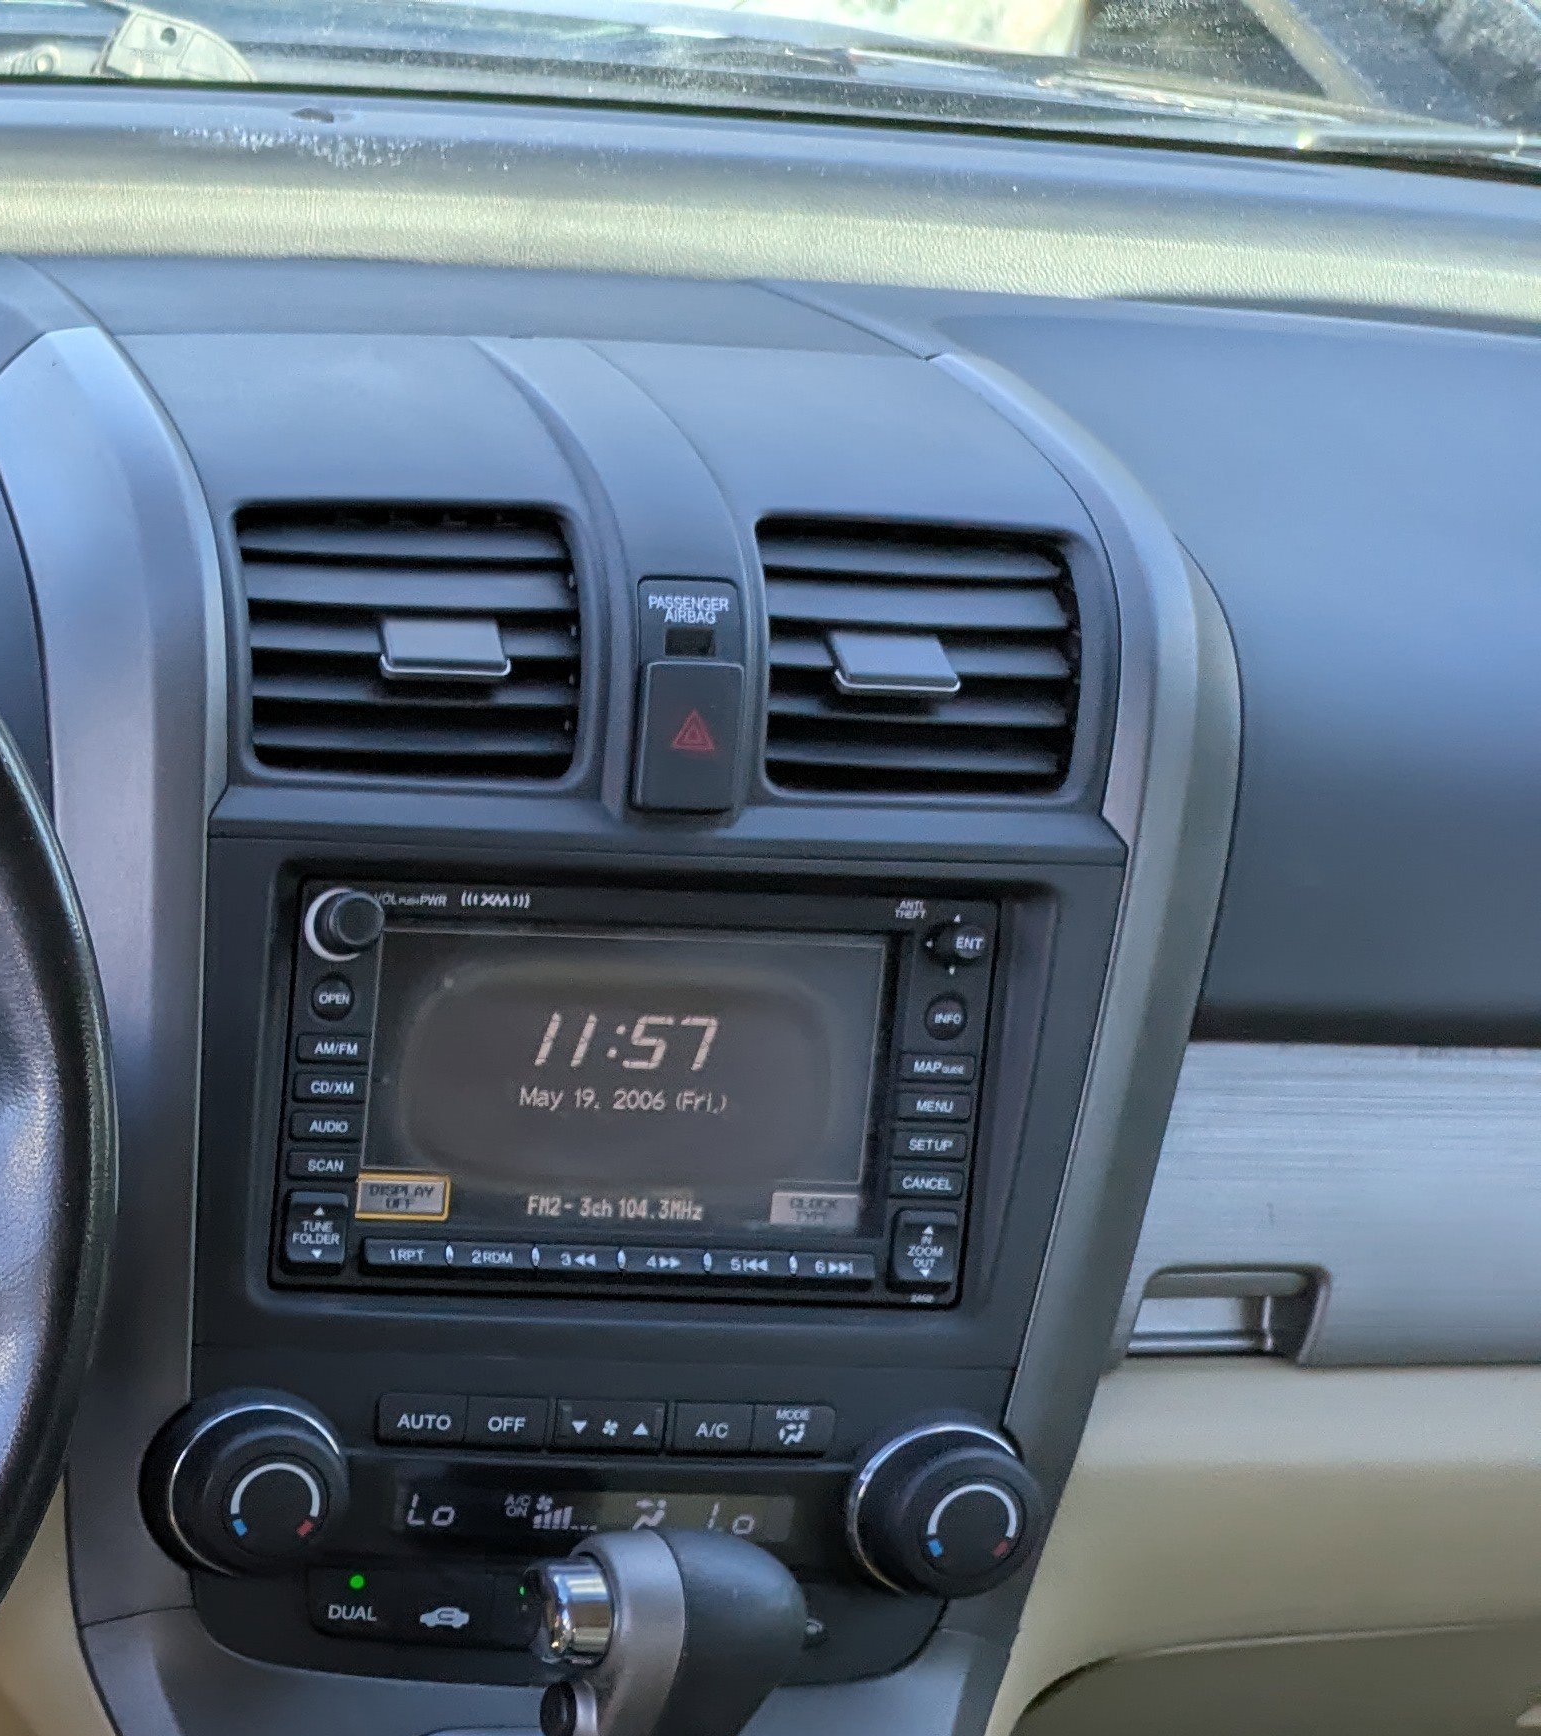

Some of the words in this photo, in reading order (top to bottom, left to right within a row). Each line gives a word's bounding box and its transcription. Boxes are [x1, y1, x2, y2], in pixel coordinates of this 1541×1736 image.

[648, 594, 730, 612] PASSENGER
[663, 609, 716, 625] AIRBAG
[955, 936, 984, 950] ENT
[318, 992, 350, 1005] OPEN
[934, 1012, 962, 1025] INFO
[534, 1011, 718, 1071] 11:57
[314, 1042, 358, 1056] AM/FM
[913, 1059, 942, 1074] MAP
[310, 1080, 354, 1095] CD/XM
[519, 1085, 564, 1111] May
[612, 1087, 666, 1111] 2006
[916, 1099, 954, 1114] MENU
[309, 1119, 349, 1134] AUDIO
[307, 1158, 345, 1173] SCAN
[902, 1175, 952, 1191] CANCEL
[301, 1220, 334, 1232] TUNE
[292, 1231, 339, 1245] FOLDER
[907, 1245, 944, 1257] ZOOM
[397, 1412, 453, 1431] AUTO
[776, 1408, 810, 1421] MODE
[487, 1416, 526, 1433] OFF
[695, 1421, 729, 1440] A/C
[328, 1604, 378, 1622] DUAL
